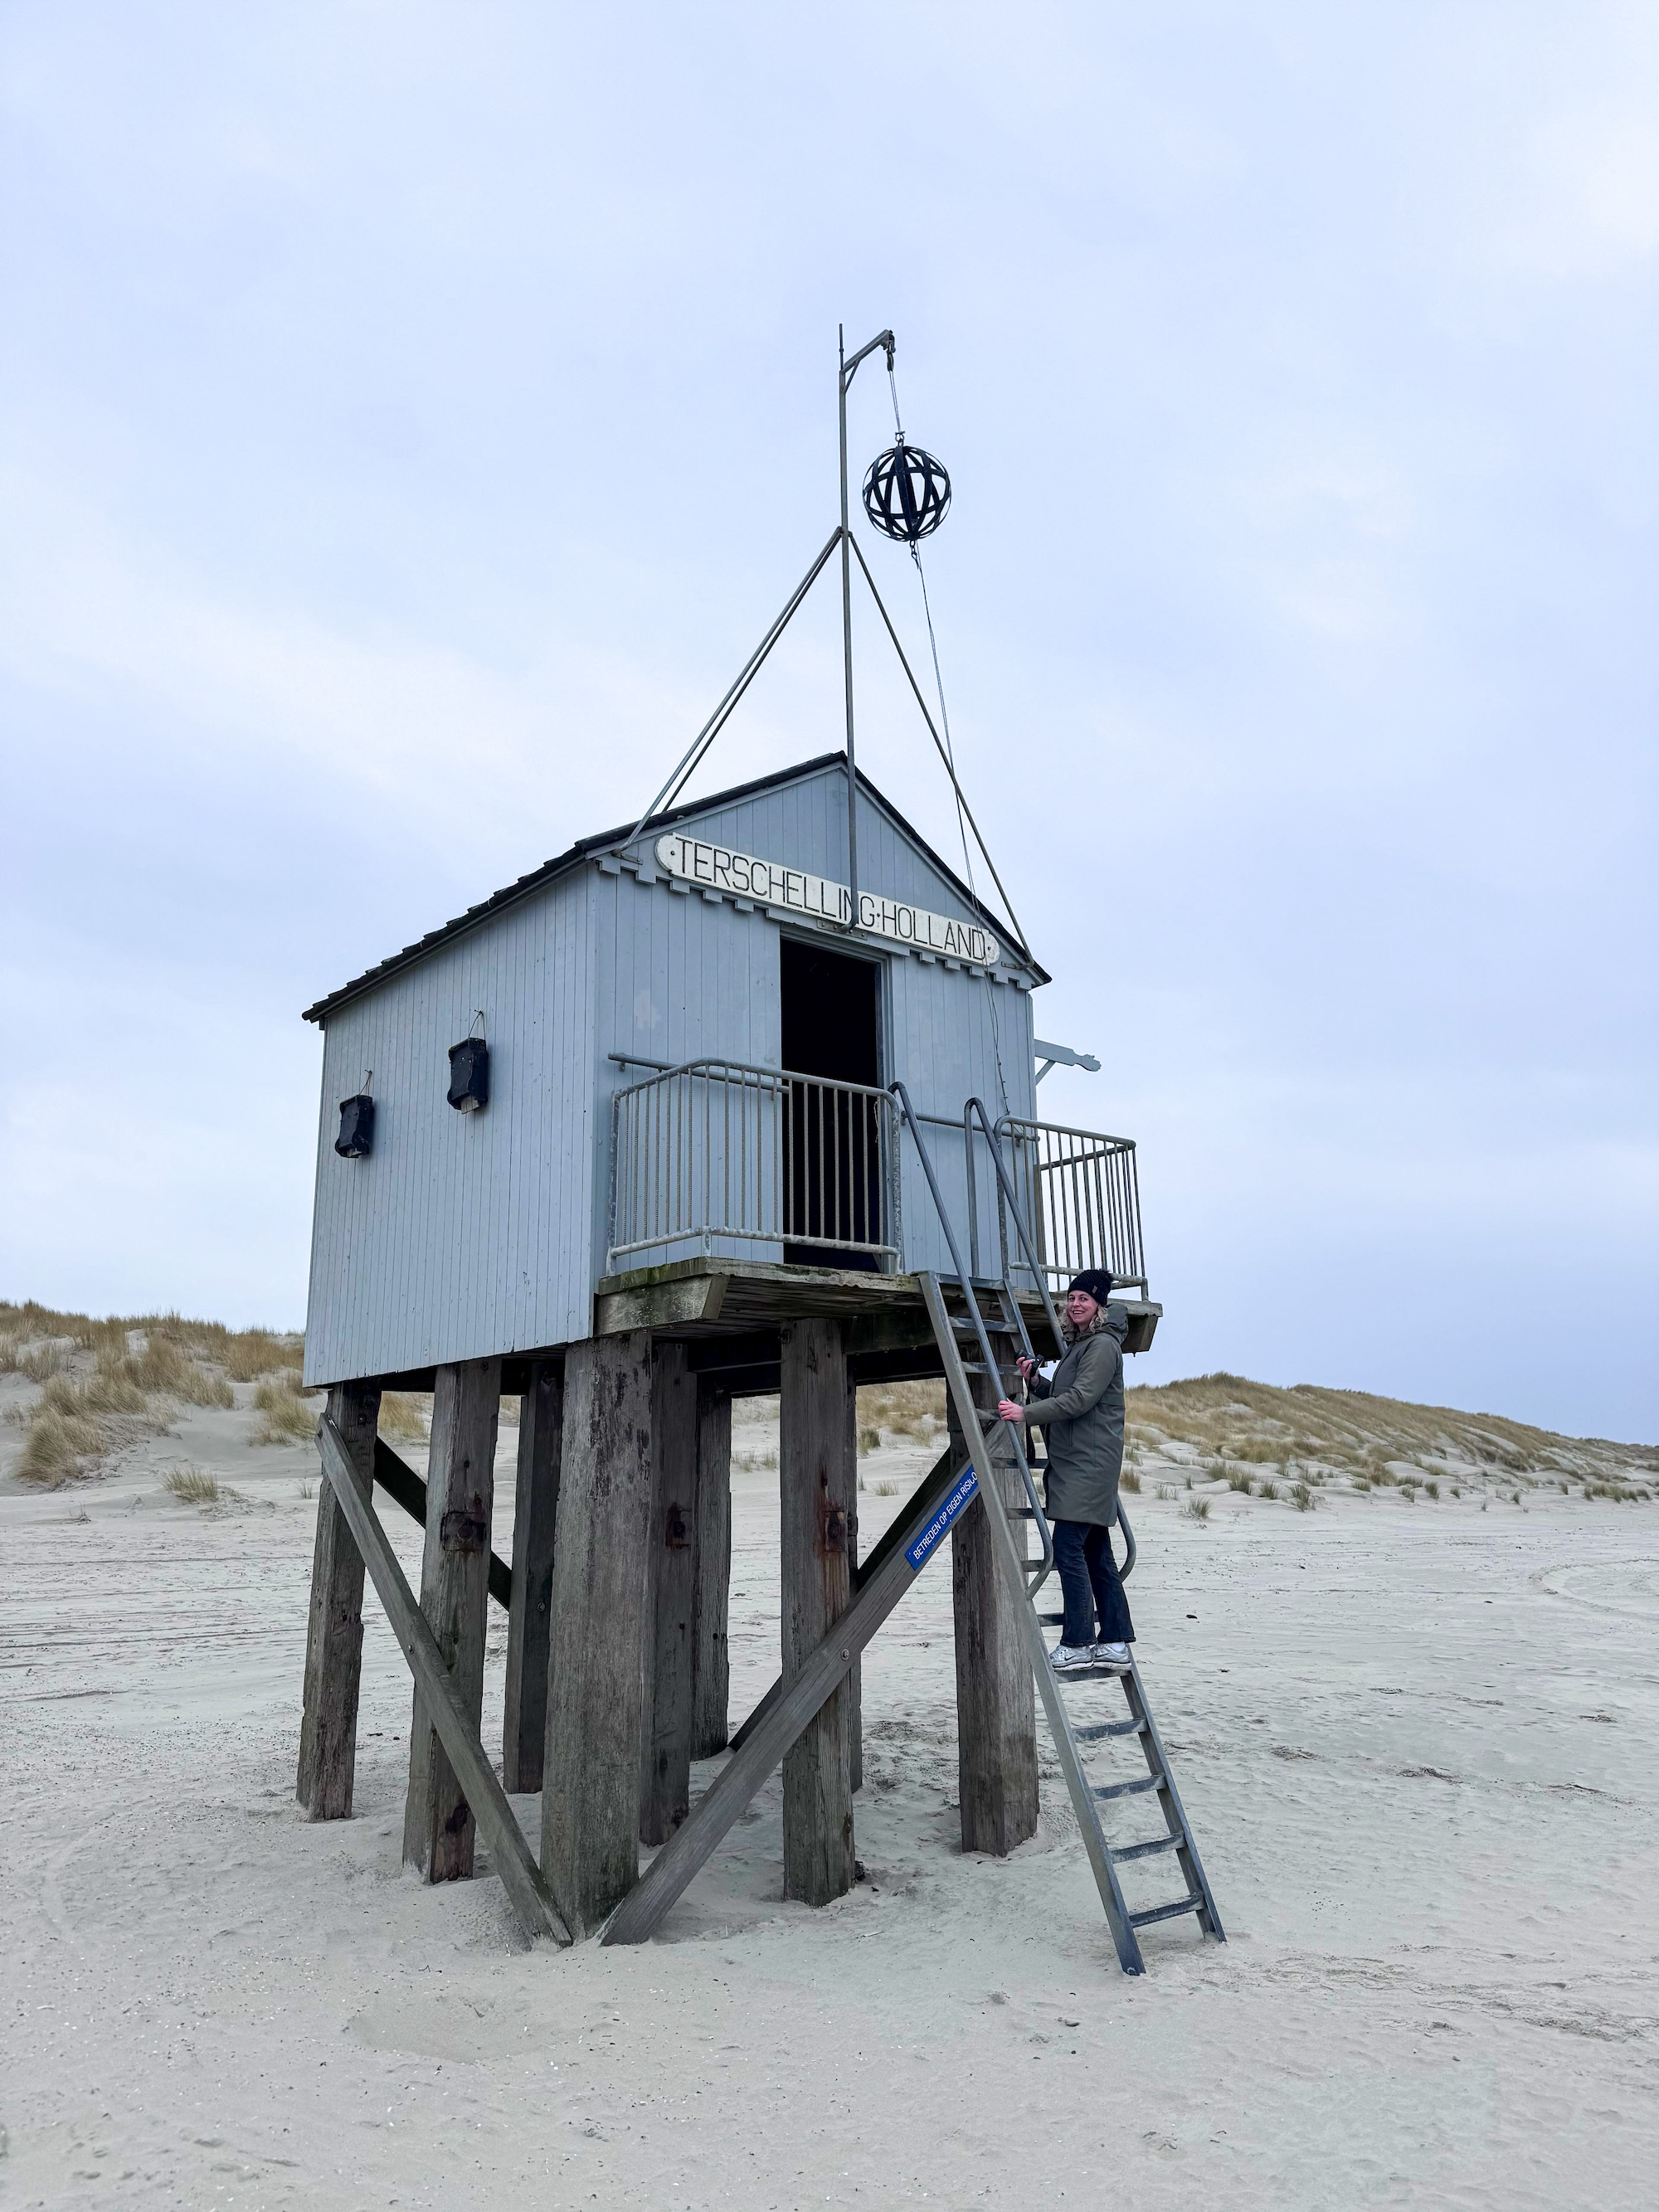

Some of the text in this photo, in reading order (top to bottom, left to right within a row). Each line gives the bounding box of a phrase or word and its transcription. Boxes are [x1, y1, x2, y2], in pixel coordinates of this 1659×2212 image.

[881, 900, 985, 961] HOLLAND
[912, 1521, 941, 1559] BETREDEN
[938, 1511, 948, 1524] OP
[946, 1492, 963, 1515] EIGEN
